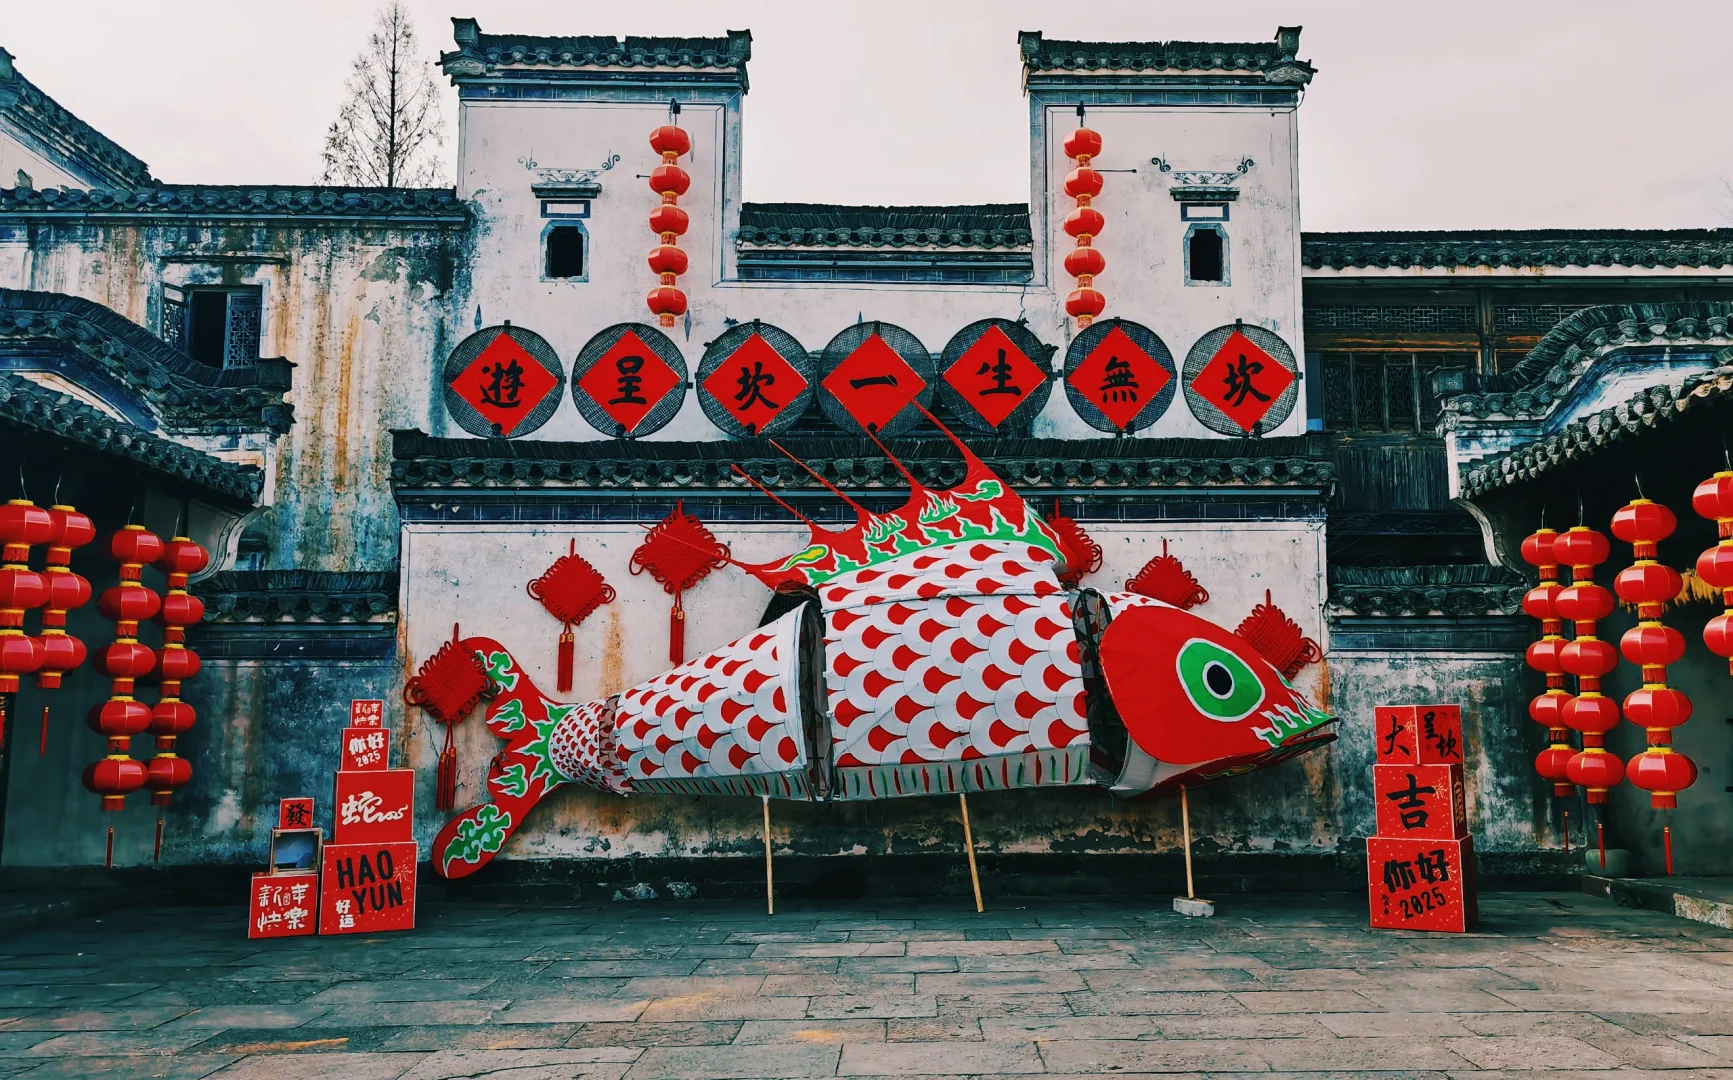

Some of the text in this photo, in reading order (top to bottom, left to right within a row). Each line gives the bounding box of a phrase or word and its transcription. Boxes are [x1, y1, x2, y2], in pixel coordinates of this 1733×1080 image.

[608, 355, 648, 406] 呈
[735, 361, 780, 411] 坎
[850, 374, 897, 389] 一
[975, 348, 1022, 397] 生
[1099, 355, 1140, 404] 無
[1222, 353, 1272, 408] 坎
[349, 732, 385, 756] 你好
[1383, 715, 1410, 756] 大
[355, 749, 381, 768] 2025
[341, 791, 408, 826] 蛇
[1386, 773, 1437, 831] 吉
[336, 850, 394, 890] HAO
[1383, 849, 1450, 894] 你好
[335, 899, 356, 929] 好运
[351, 880, 404, 915] YUN
[1399, 886, 1447, 920] 2025
[256, 906, 309, 933] 快樂
